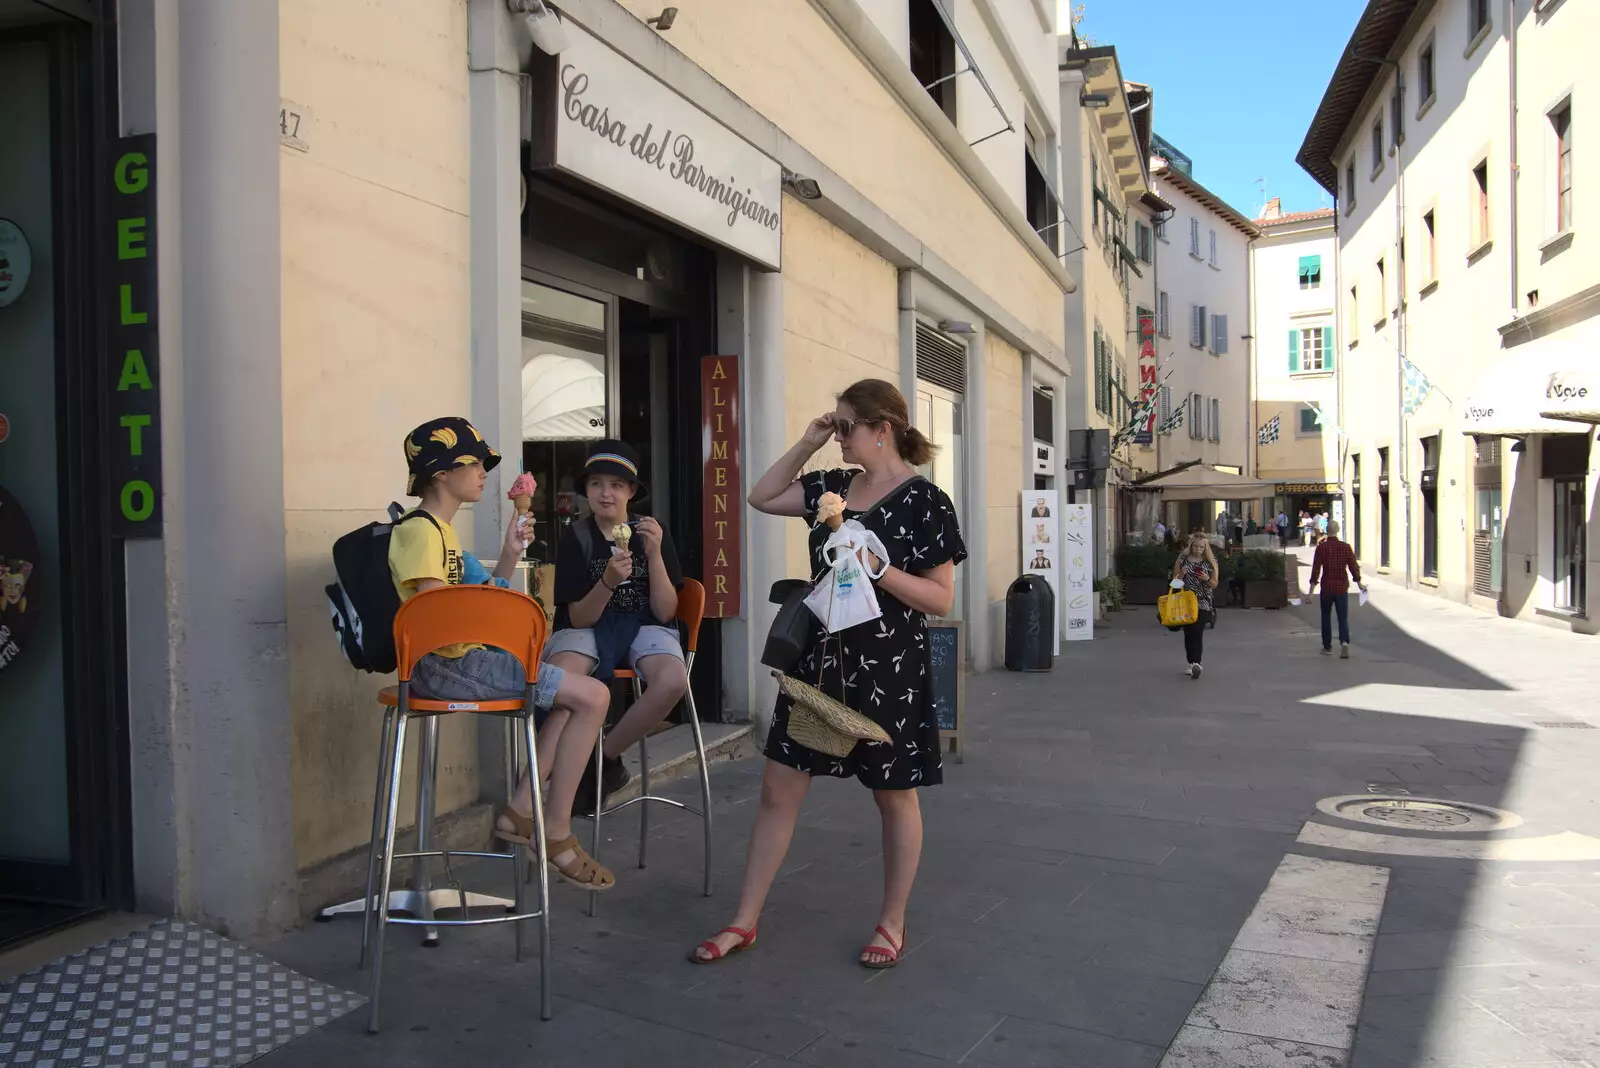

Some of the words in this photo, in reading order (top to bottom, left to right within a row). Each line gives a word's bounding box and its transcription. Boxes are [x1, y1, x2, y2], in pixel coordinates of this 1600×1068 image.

[561, 64, 626, 147] Casa
[630, 123, 674, 170] del
[670, 134, 780, 231] Parmigiano
[113, 151, 155, 522] GELATO
[711, 360, 729, 618] ALIMENTARI
